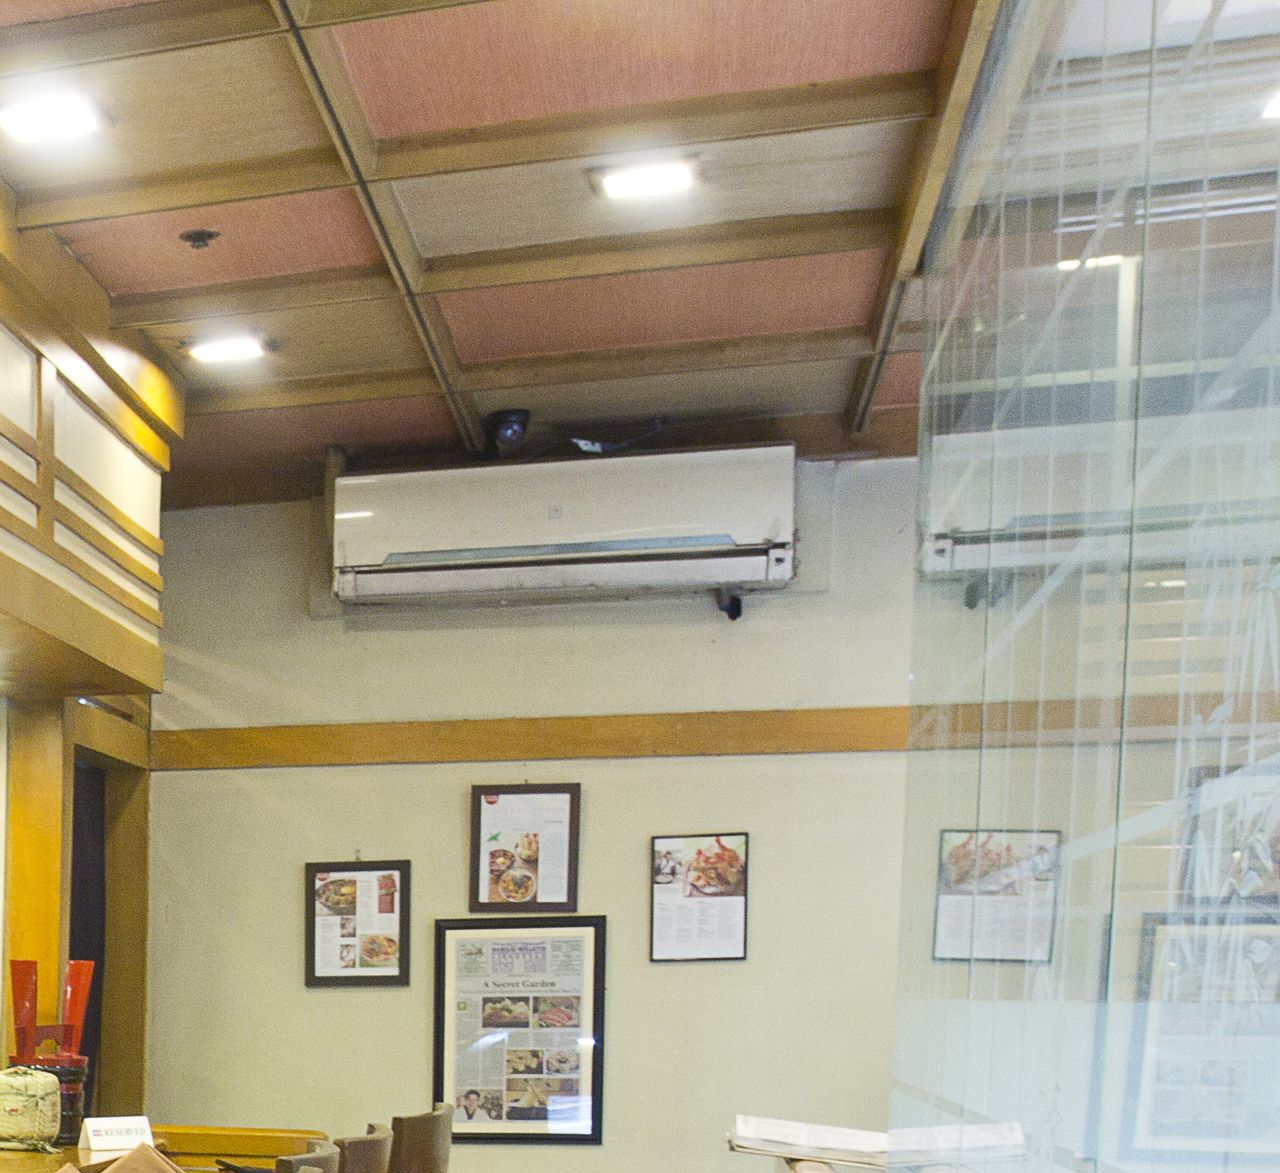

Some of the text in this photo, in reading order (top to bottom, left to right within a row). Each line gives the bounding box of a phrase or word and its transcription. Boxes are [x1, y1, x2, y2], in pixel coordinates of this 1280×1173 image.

[492, 980, 520, 988] Secret
[521, 979, 556, 988] Garden
[103, 1127, 147, 1137] RESERVED
